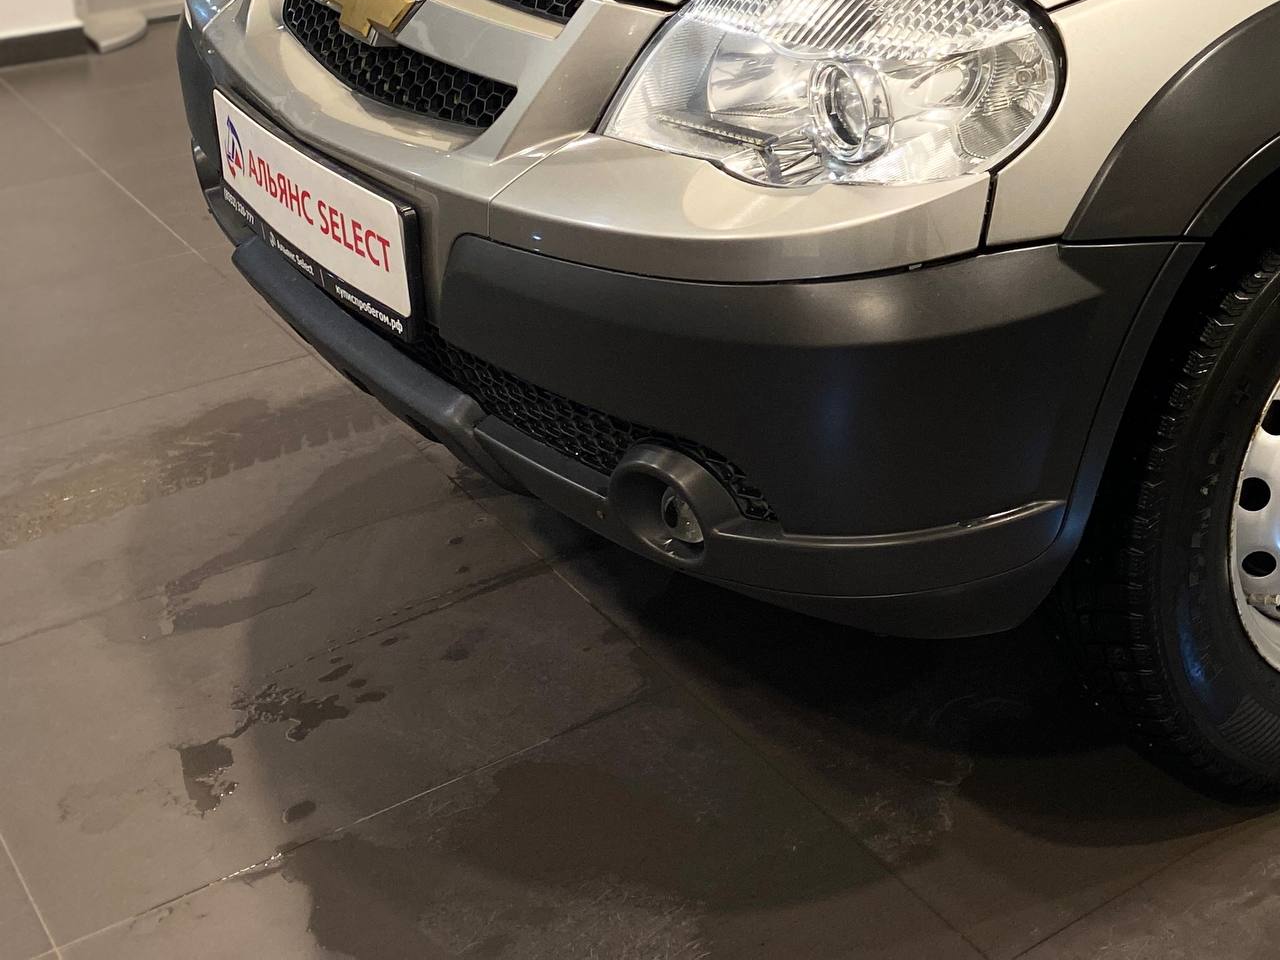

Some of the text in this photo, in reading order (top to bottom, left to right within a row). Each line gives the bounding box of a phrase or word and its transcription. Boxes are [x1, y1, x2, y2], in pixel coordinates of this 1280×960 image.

[248, 149, 390, 272] АЛЬЯНС SELECT
[335, 284, 403, 334] куписпробегом.рф
